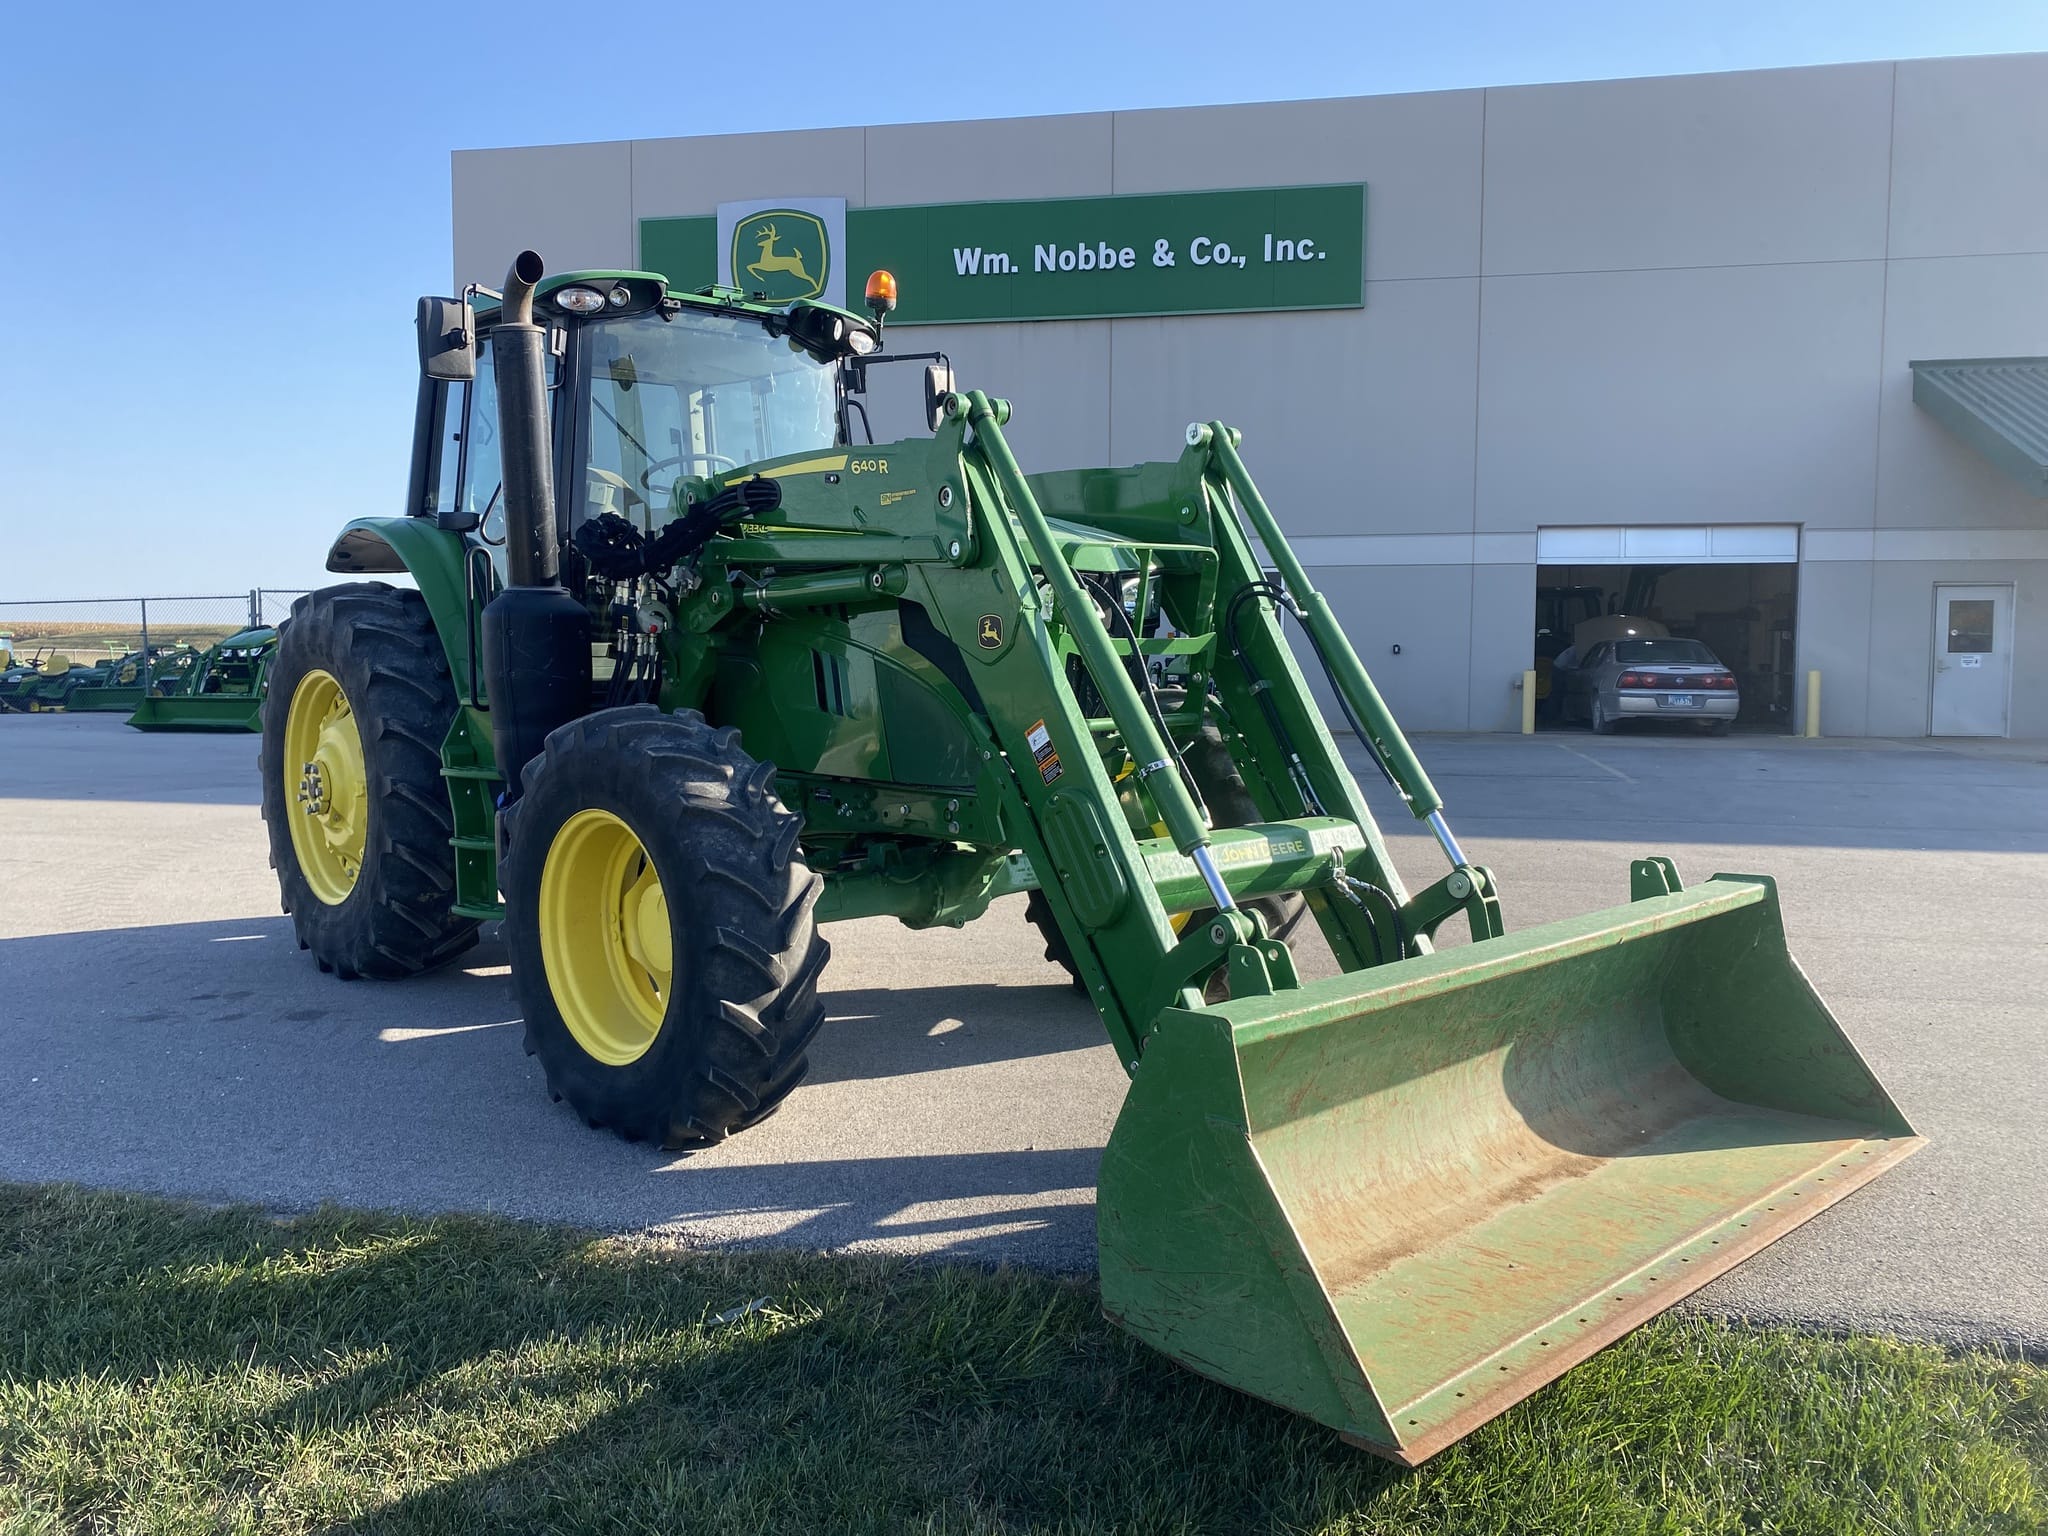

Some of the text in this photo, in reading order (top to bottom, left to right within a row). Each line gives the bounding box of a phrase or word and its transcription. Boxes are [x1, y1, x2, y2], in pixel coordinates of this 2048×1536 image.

[953, 233, 1326, 275] Wm. Nobbe & Co., Inc.
[851, 459, 889, 474] 640 R
[1223, 840, 1304, 861] JOHN DEERE
